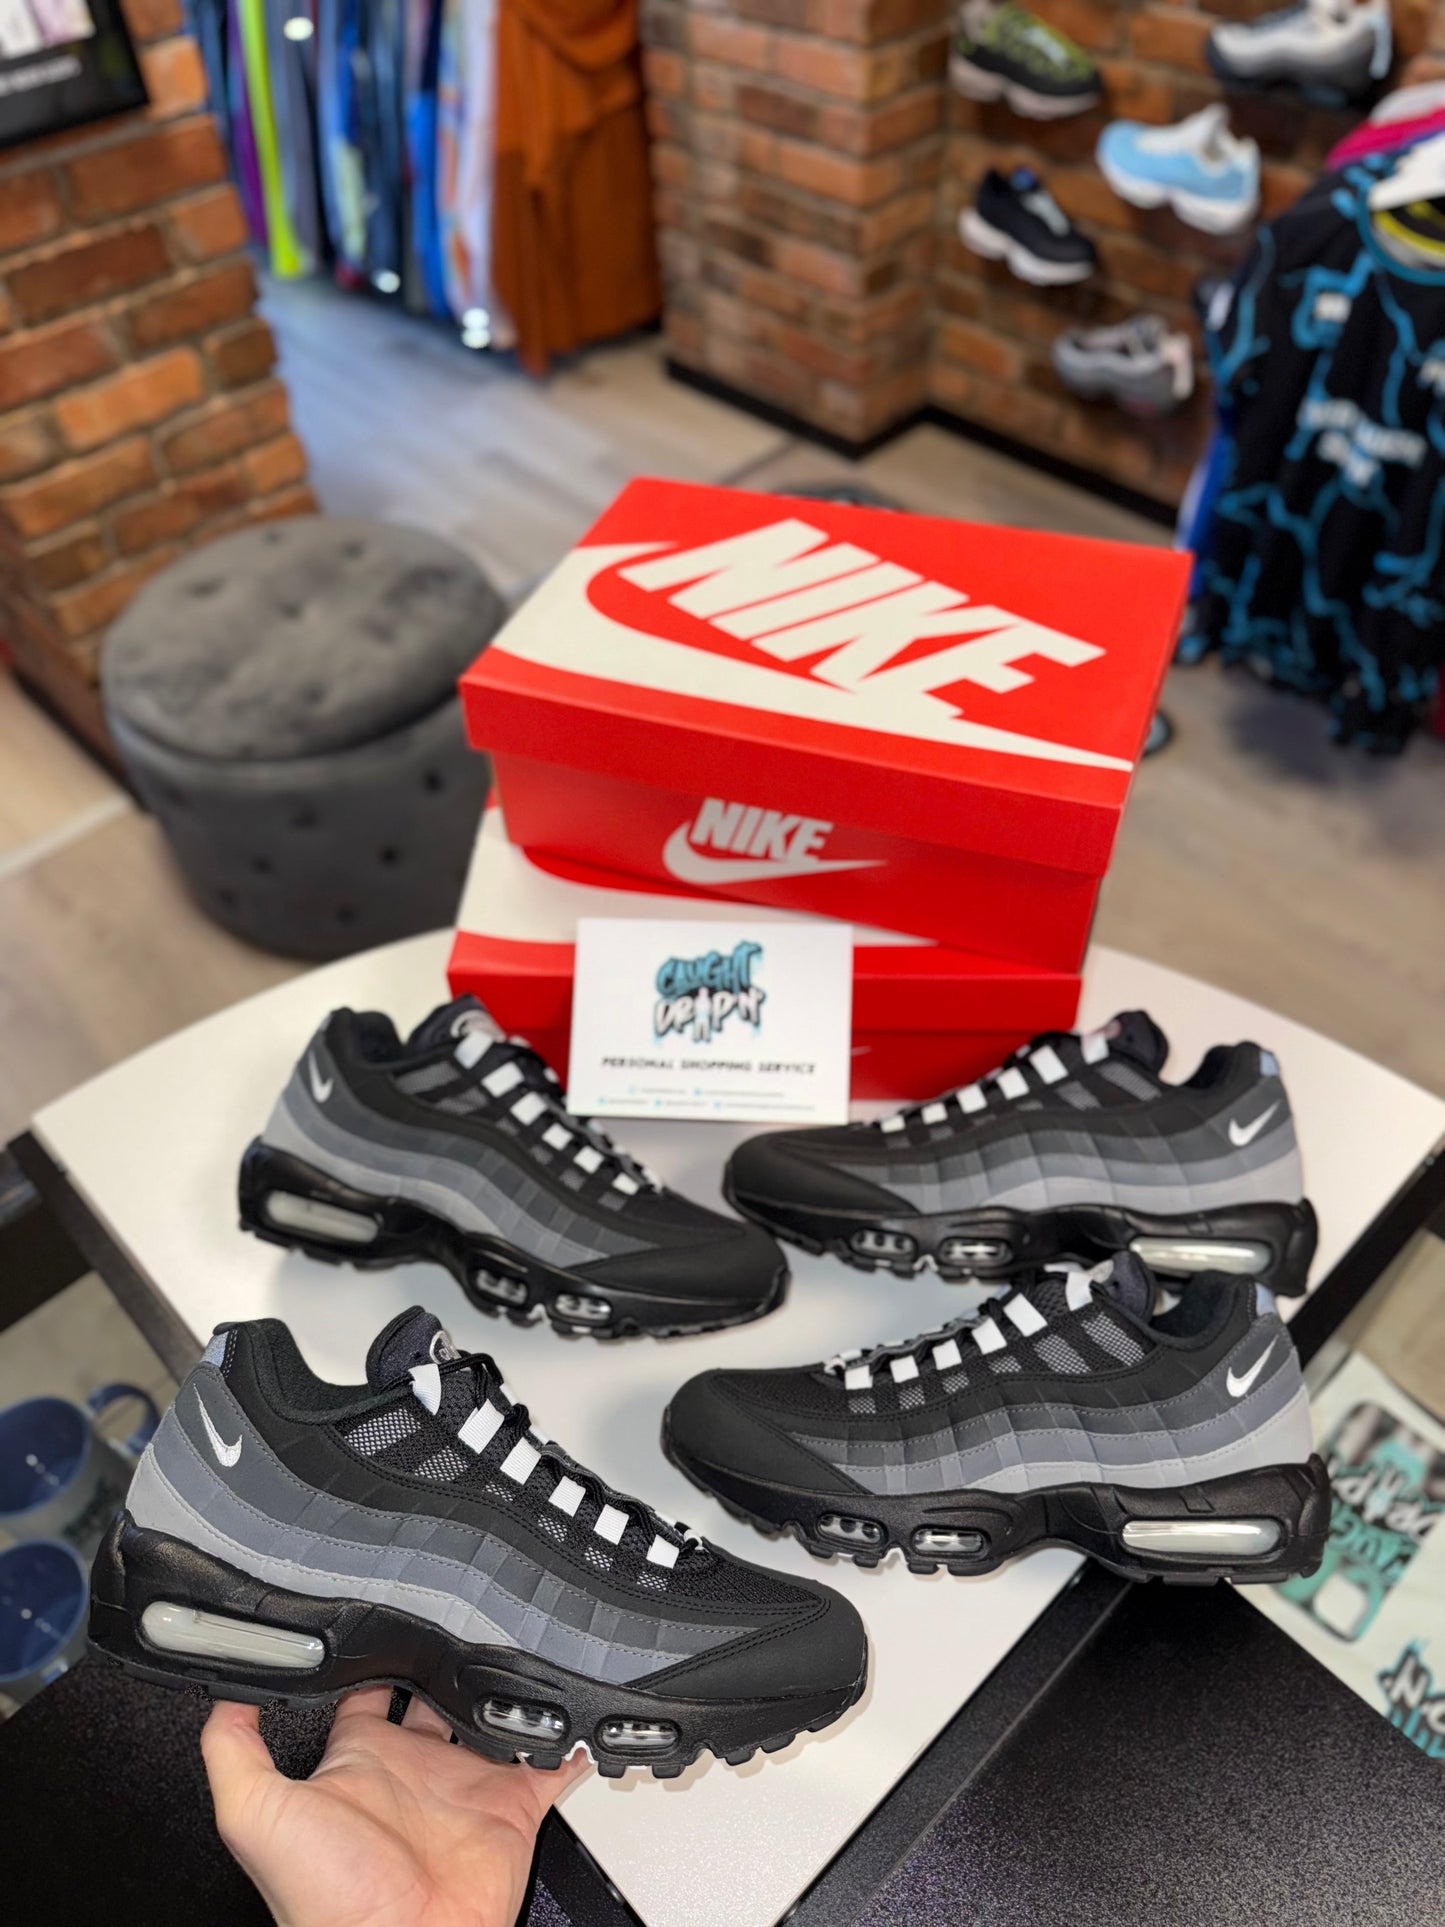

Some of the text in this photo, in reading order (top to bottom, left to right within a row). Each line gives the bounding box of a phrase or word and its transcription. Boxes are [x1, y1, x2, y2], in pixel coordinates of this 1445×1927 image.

[617, 517, 1107, 719] NIKE
[690, 797, 834, 864] NIKE
[655, 940, 763, 998] CAUGHT
[601, 1056, 817, 1075] PERSONAL SHOPPING SERVICE
